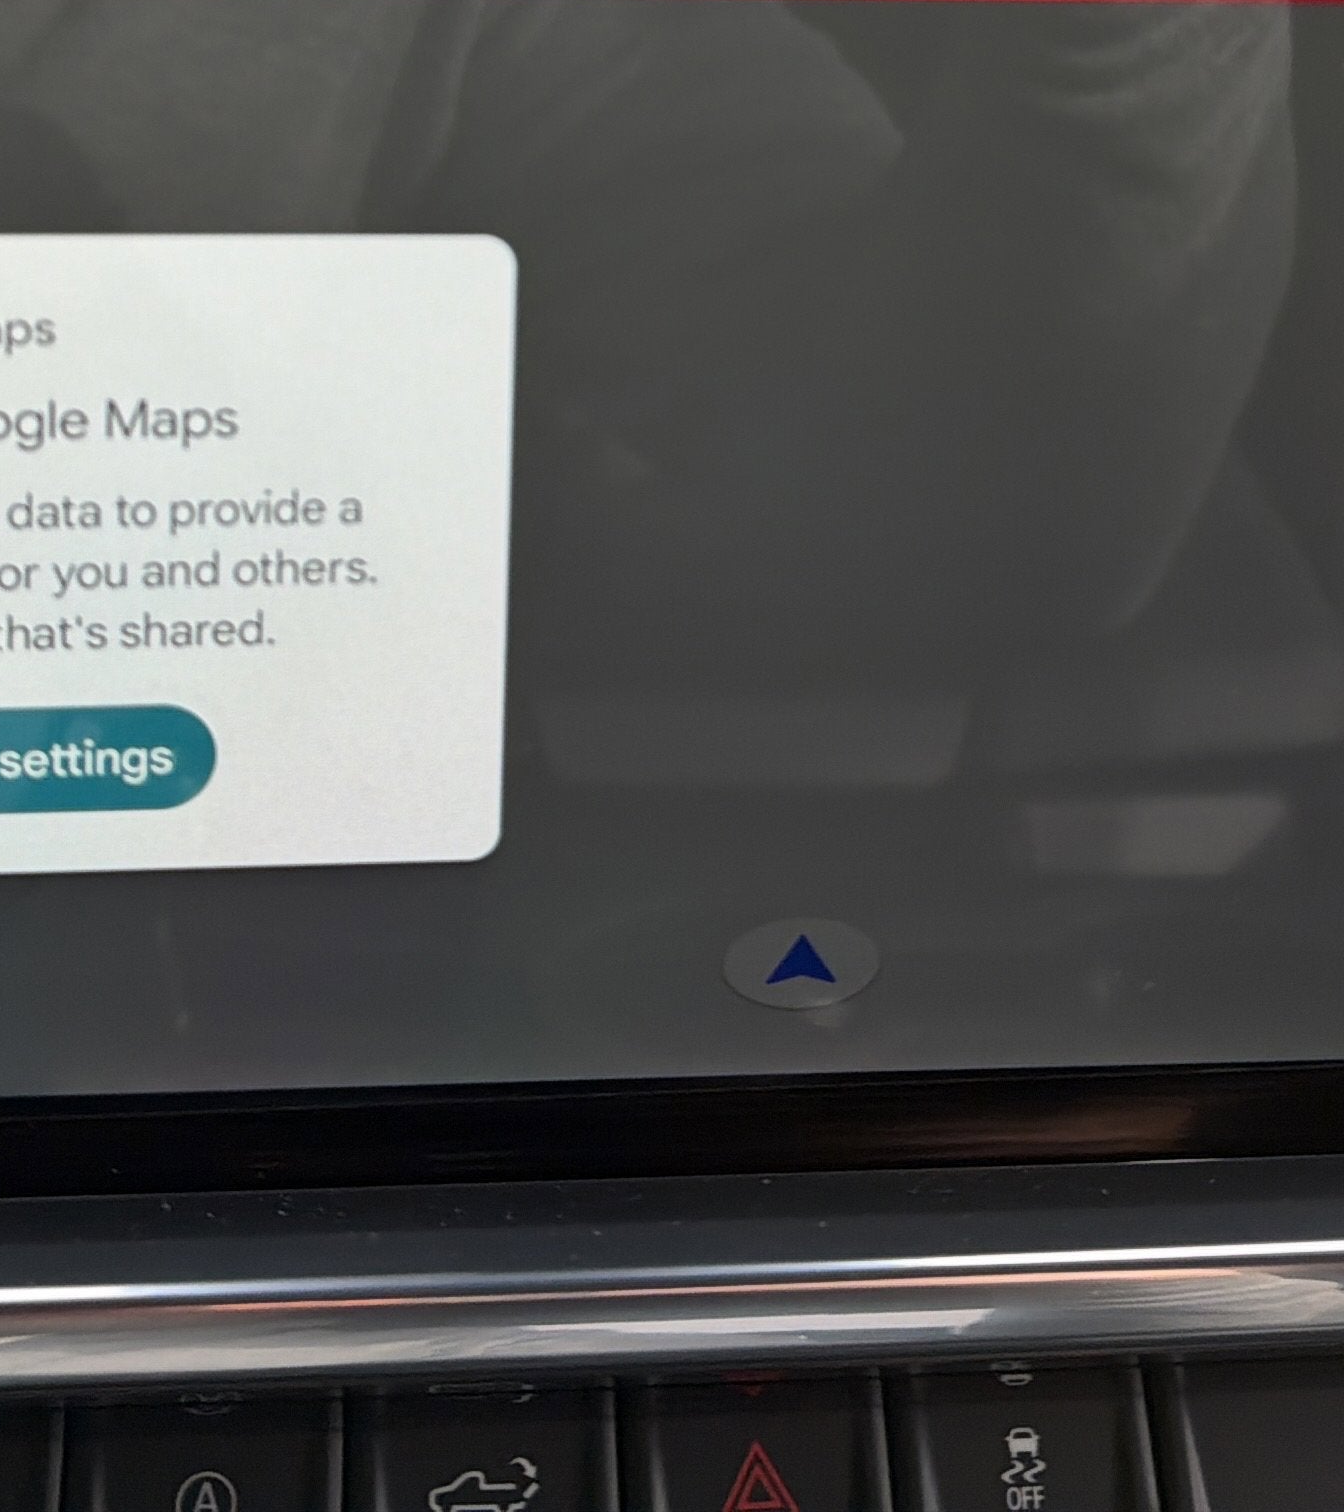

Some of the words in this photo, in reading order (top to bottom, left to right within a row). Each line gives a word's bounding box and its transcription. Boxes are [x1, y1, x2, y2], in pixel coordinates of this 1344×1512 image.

[105, 397, 240, 449] Maps
[6, 492, 103, 530] data
[116, 495, 157, 530] to
[168, 489, 326, 535] provide
[338, 496, 364, 525] a
[53, 561, 128, 597] you
[141, 550, 221, 588] and
[232, 549, 378, 587] others.
[119, 610, 276, 648] shared.
[1006, 1485, 1045, 1511] OFF
